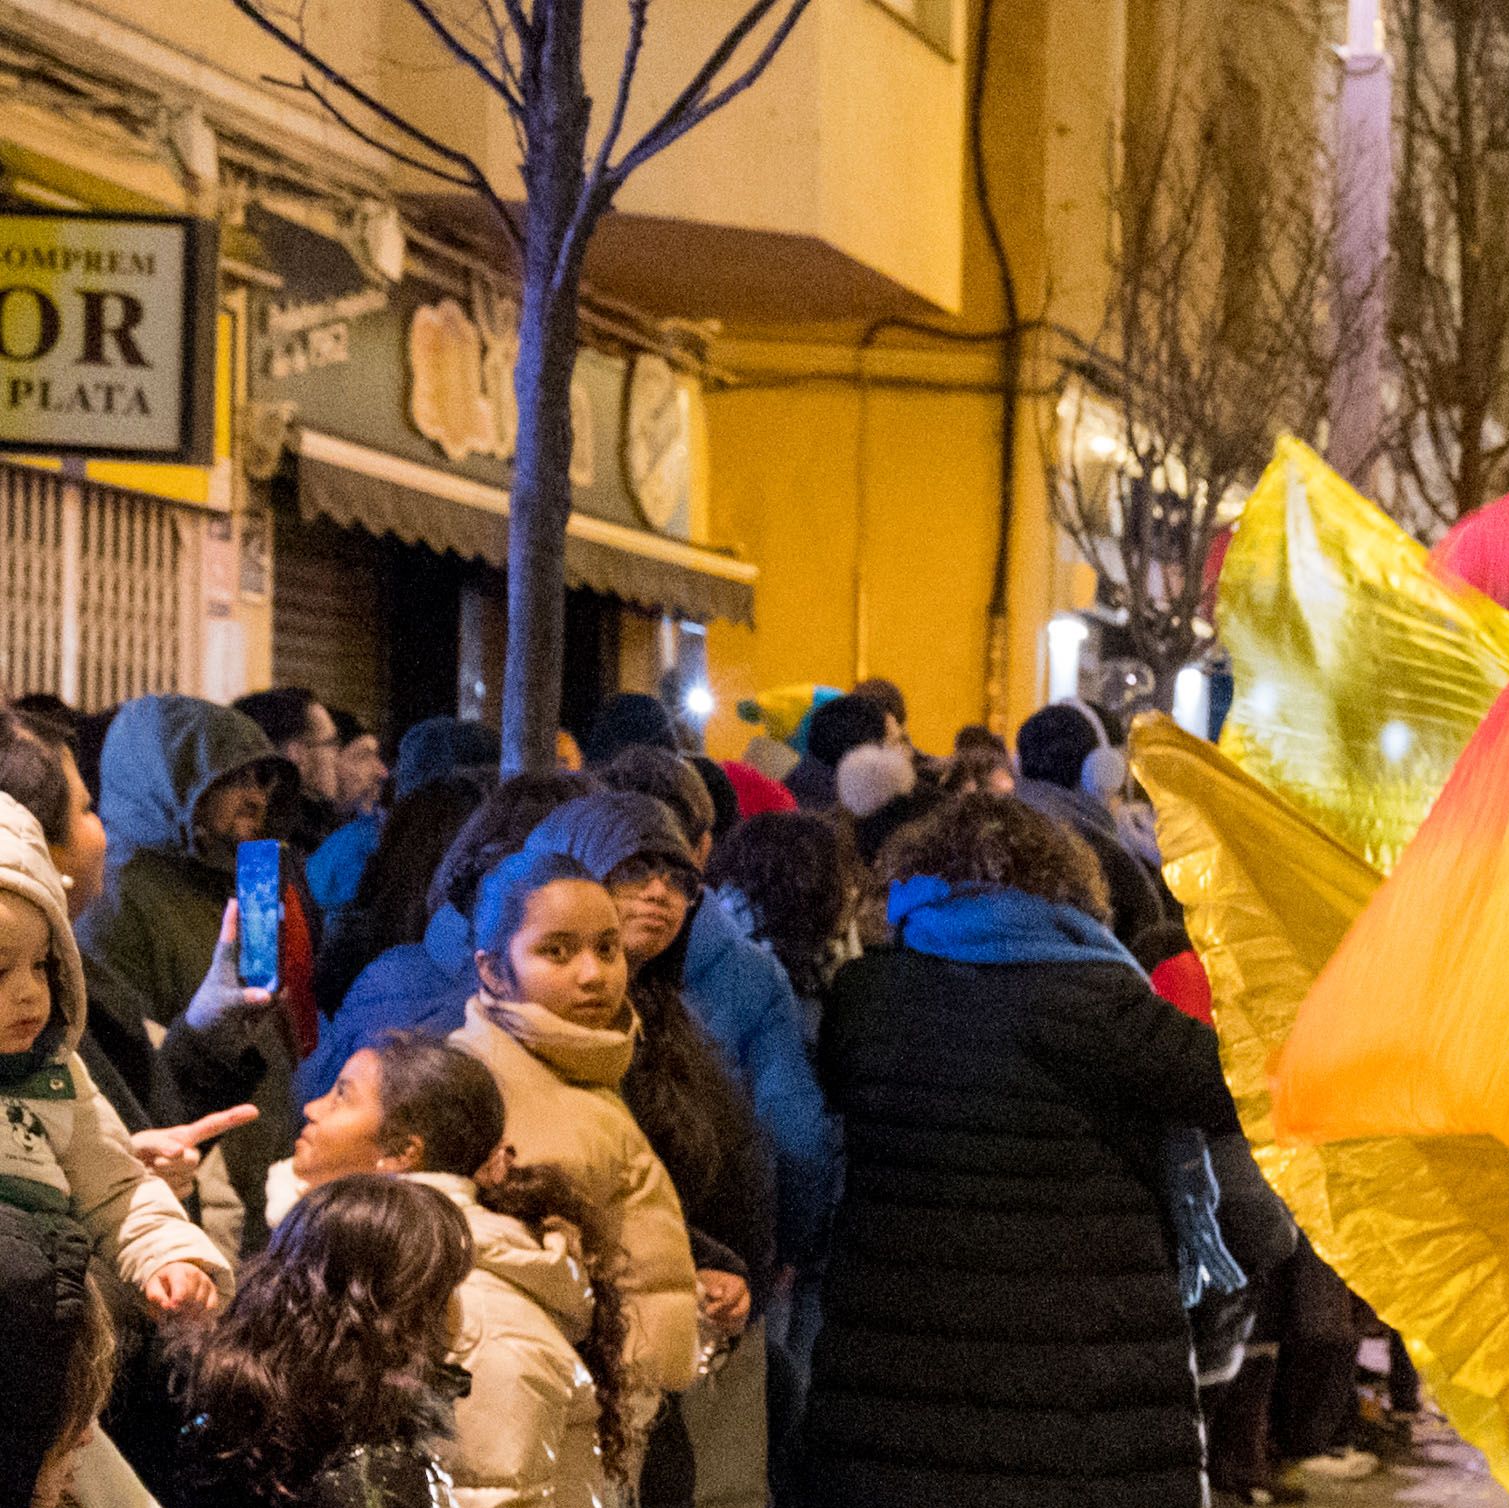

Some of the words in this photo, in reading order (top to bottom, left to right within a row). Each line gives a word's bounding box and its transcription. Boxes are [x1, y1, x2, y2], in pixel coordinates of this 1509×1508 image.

[0, 246, 157, 277] OMPREM
[0, 284, 153, 369] OR
[8, 376, 152, 417] PLATA
